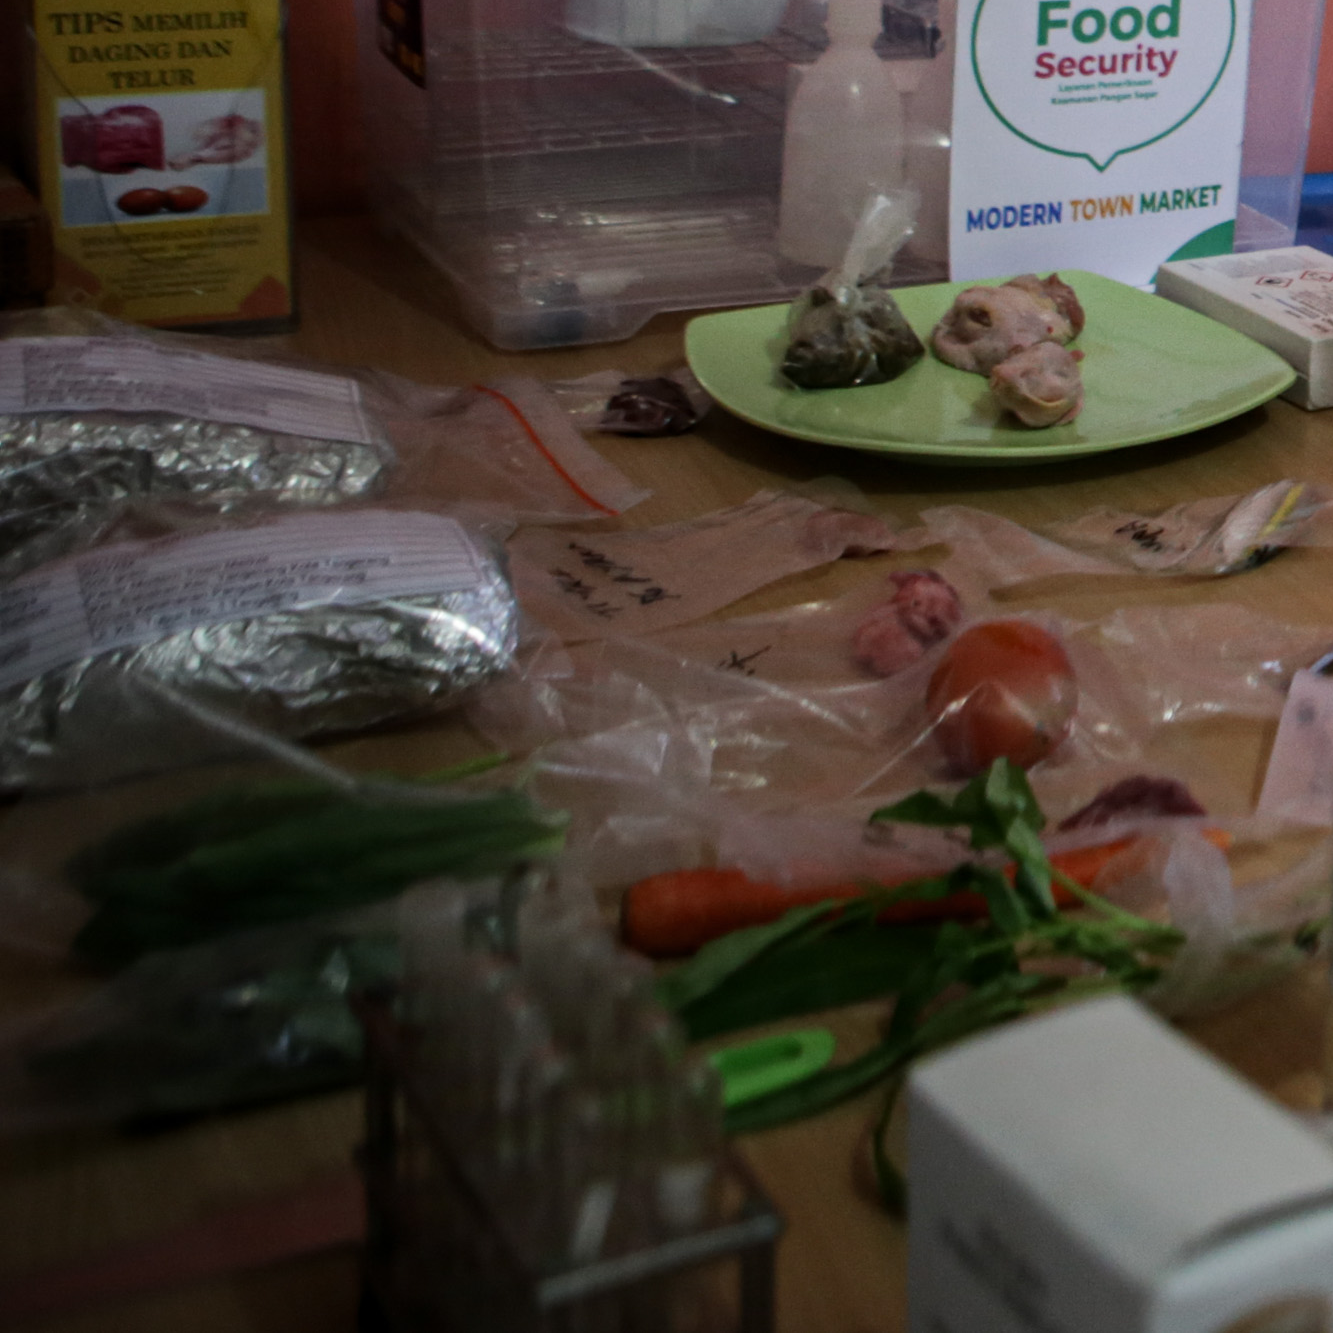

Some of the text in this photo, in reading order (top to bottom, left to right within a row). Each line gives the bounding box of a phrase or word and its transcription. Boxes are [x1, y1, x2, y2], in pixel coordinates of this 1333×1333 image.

[49, 10, 249, 36] TIPS MEMILIH
[67, 39, 234, 64] DAGING DAN
[1034, 43, 1179, 79] Security
[107, 68, 196, 89] TELUR
[966, 184, 1223, 233] MODERN TOWN MARKET
